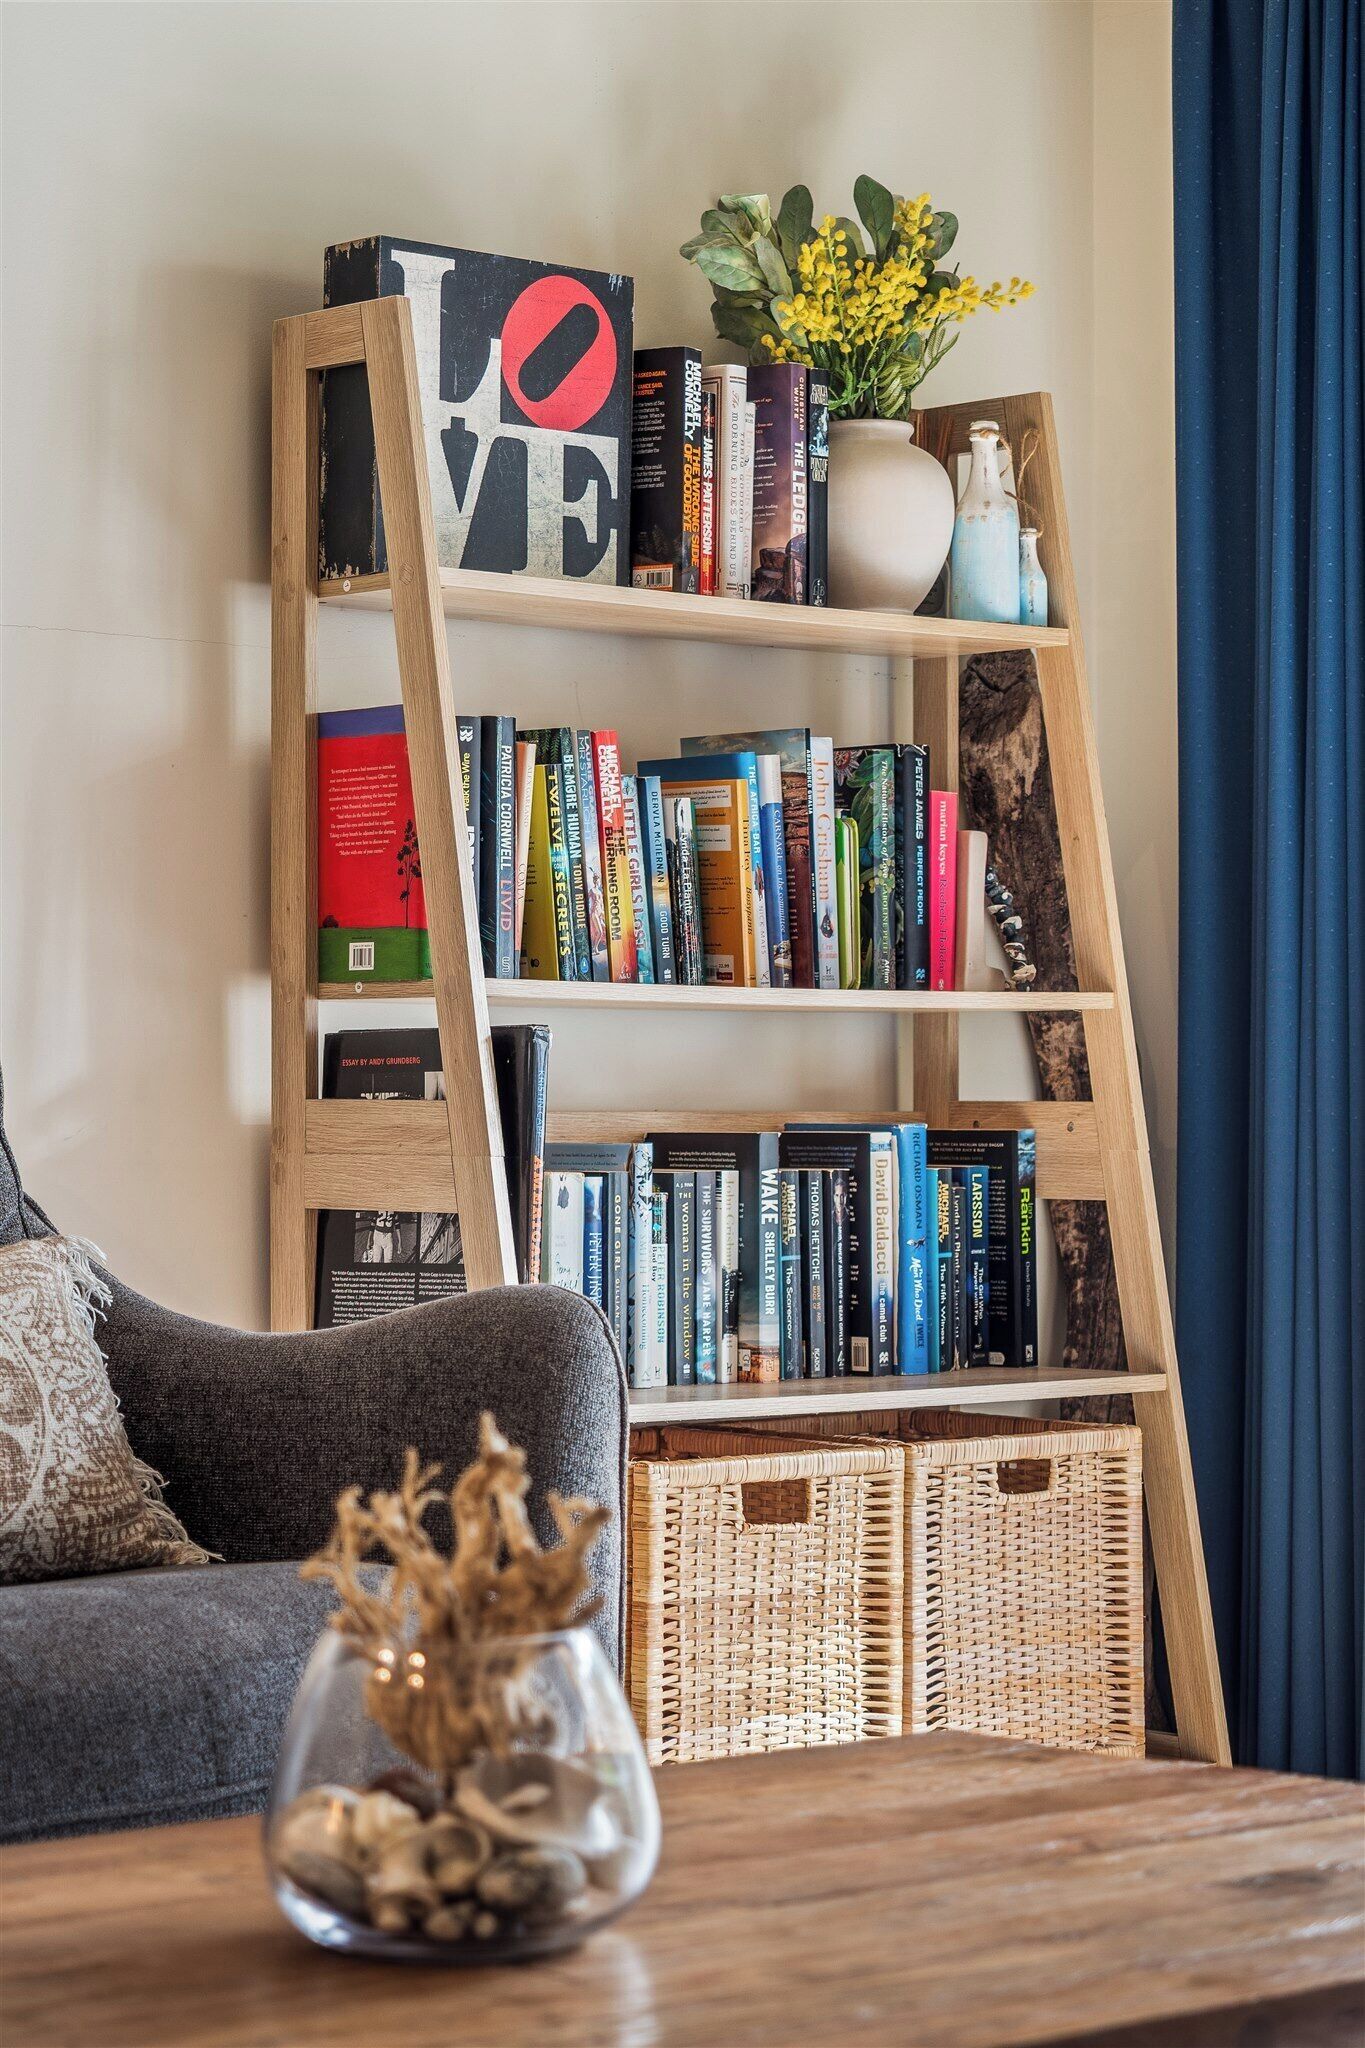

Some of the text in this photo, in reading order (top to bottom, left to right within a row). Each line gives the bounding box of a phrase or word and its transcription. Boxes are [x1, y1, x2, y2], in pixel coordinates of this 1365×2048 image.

[684, 359, 694, 441] CONNELLY
[692, 362, 702, 432] MICHAEL
[730, 412, 738, 470] MORNING
[684, 443, 693, 532] OF GOODBYE
[692, 446, 700, 567] THE WRONG SIDE
[703, 436, 713, 555] JAMES PATTERSON
[792, 441, 806, 537] THE LEDGE
[729, 563, 737, 577] US
[461, 753, 470, 791] the Wire
[563, 754, 574, 770] BE
[578, 737, 591, 840] MR STARLIGHT
[606, 744, 621, 811] MICHAEL
[881, 761, 889, 776] The
[751, 792, 759, 828] AFRICA
[881, 779, 889, 811] Natural
[500, 745, 512, 932] PATRICIA CORNWELL LIVID
[567, 813, 582, 858] HUMAN
[598, 744, 622, 941] CONNELLY BURNING ROOM
[651, 792, 666, 883] DERVLA McTIERNAN
[680, 833, 690, 863] Lynda
[753, 833, 761, 854] BAR
[774, 810, 784, 862] CARNAGE
[813, 758, 832, 901] John Grisham
[880, 813, 889, 845] History
[880, 847, 889, 857] of
[915, 758, 924, 926] PETER JAMES PERFECT PEOPLE
[938, 801, 949, 875] marian keyes
[549, 770, 571, 956] TWELVE SECRETS
[573, 863, 583, 890] TONY
[624, 798, 647, 951] LITTLE GIRLS LOST
[778, 865, 783, 875] on
[575, 893, 586, 929] RIDDLE
[683, 882, 693, 916] Plante
[746, 887, 755, 935] Bossypants
[778, 893, 787, 933] committee
[660, 911, 670, 959] GOOD TURN
[386, 1057, 421, 1065] GRUNDBERG
[537, 1071, 545, 1108] KRISTIN
[781, 1180, 789, 1245] CONNELLY
[786, 1184, 796, 1242] MICHAEL
[811, 1180, 820, 1281] THOMAS HETTCHE
[914, 1185, 923, 1229] OSMAN
[941, 1182, 950, 1239] MICHAEL
[953, 1193, 961, 1224] Lynda
[971, 1173, 983, 1238] LARSSON
[1020, 1187, 1031, 1255] Rankin
[589, 1232, 599, 1272] PETER
[683, 1258, 691, 1272] in
[761, 1168, 779, 1315] WAKE SHELLEY BURR
[876, 1158, 890, 1343] David Baldacci the camel club
[657, 1246, 665, 1344] PETER ROBINSON
[683, 1277, 691, 1299] the
[701, 1184, 712, 1358] THE SURVIVORS JANE HARPER
[914, 1279, 924, 1300] Who
[640, 1284, 650, 1351] Homecoming
[683, 1304, 692, 1359] window
[913, 1299, 924, 1321] Died
